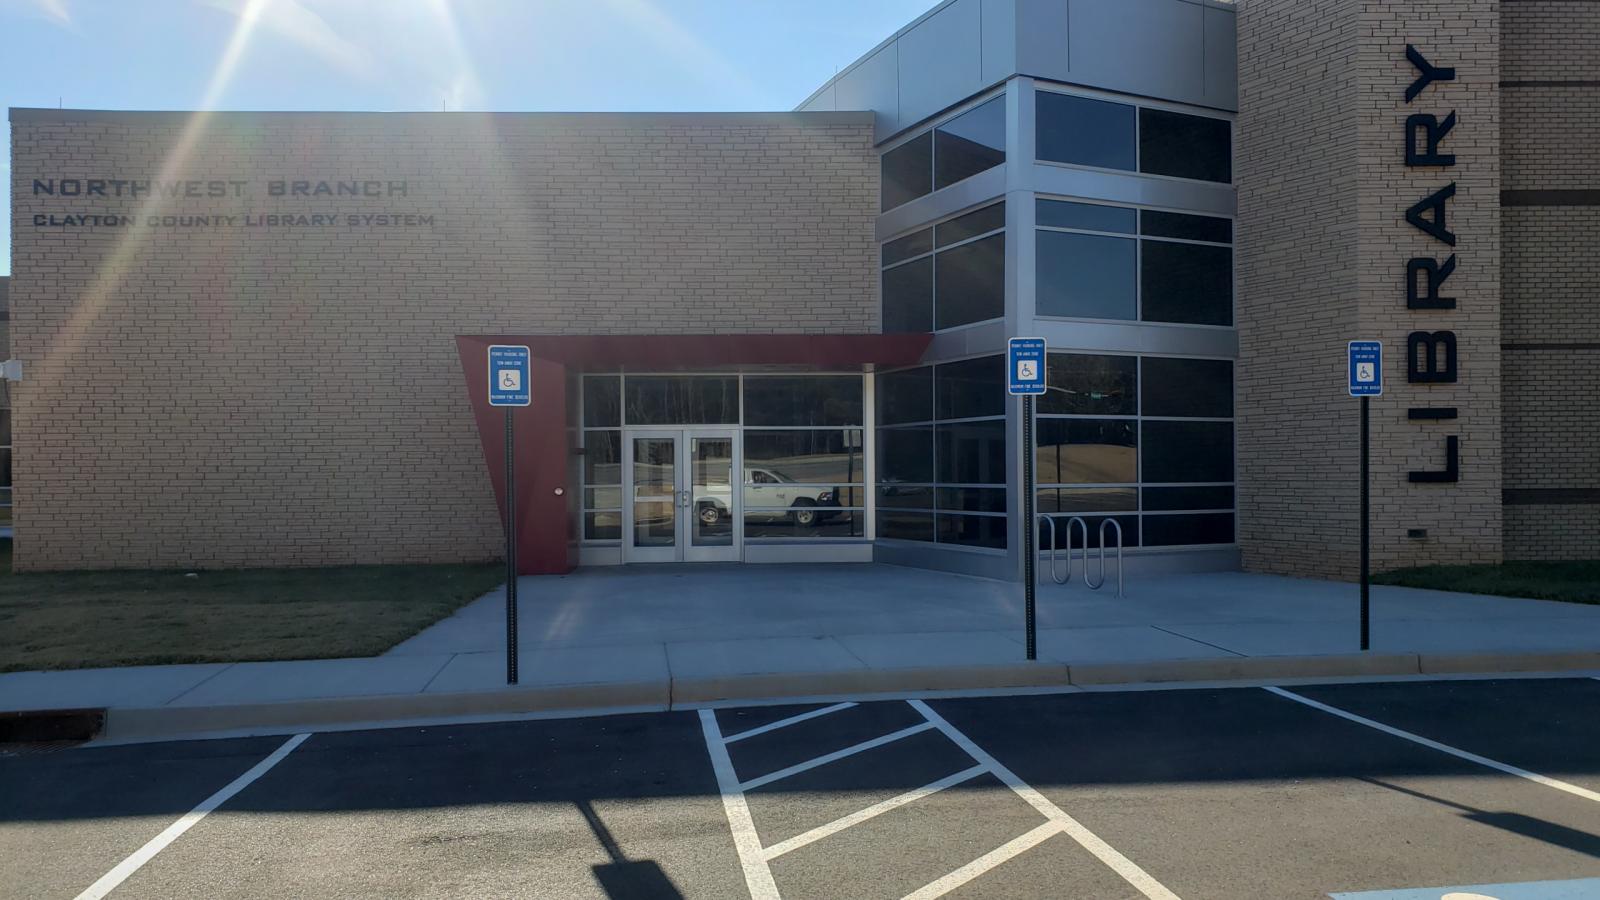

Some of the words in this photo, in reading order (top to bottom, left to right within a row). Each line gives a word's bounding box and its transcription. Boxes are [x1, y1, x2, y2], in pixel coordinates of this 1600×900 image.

[33, 179, 248, 196] NORTHWEST
[267, 180, 408, 197] BRANCH
[33, 214, 136, 227] CLAYTON
[147, 215, 236, 227] COUNTY
[245, 214, 338, 226] LIBRARY
[347, 214, 434, 226] SYSTEM
[1406, 44, 1458, 482] LIBRARY
